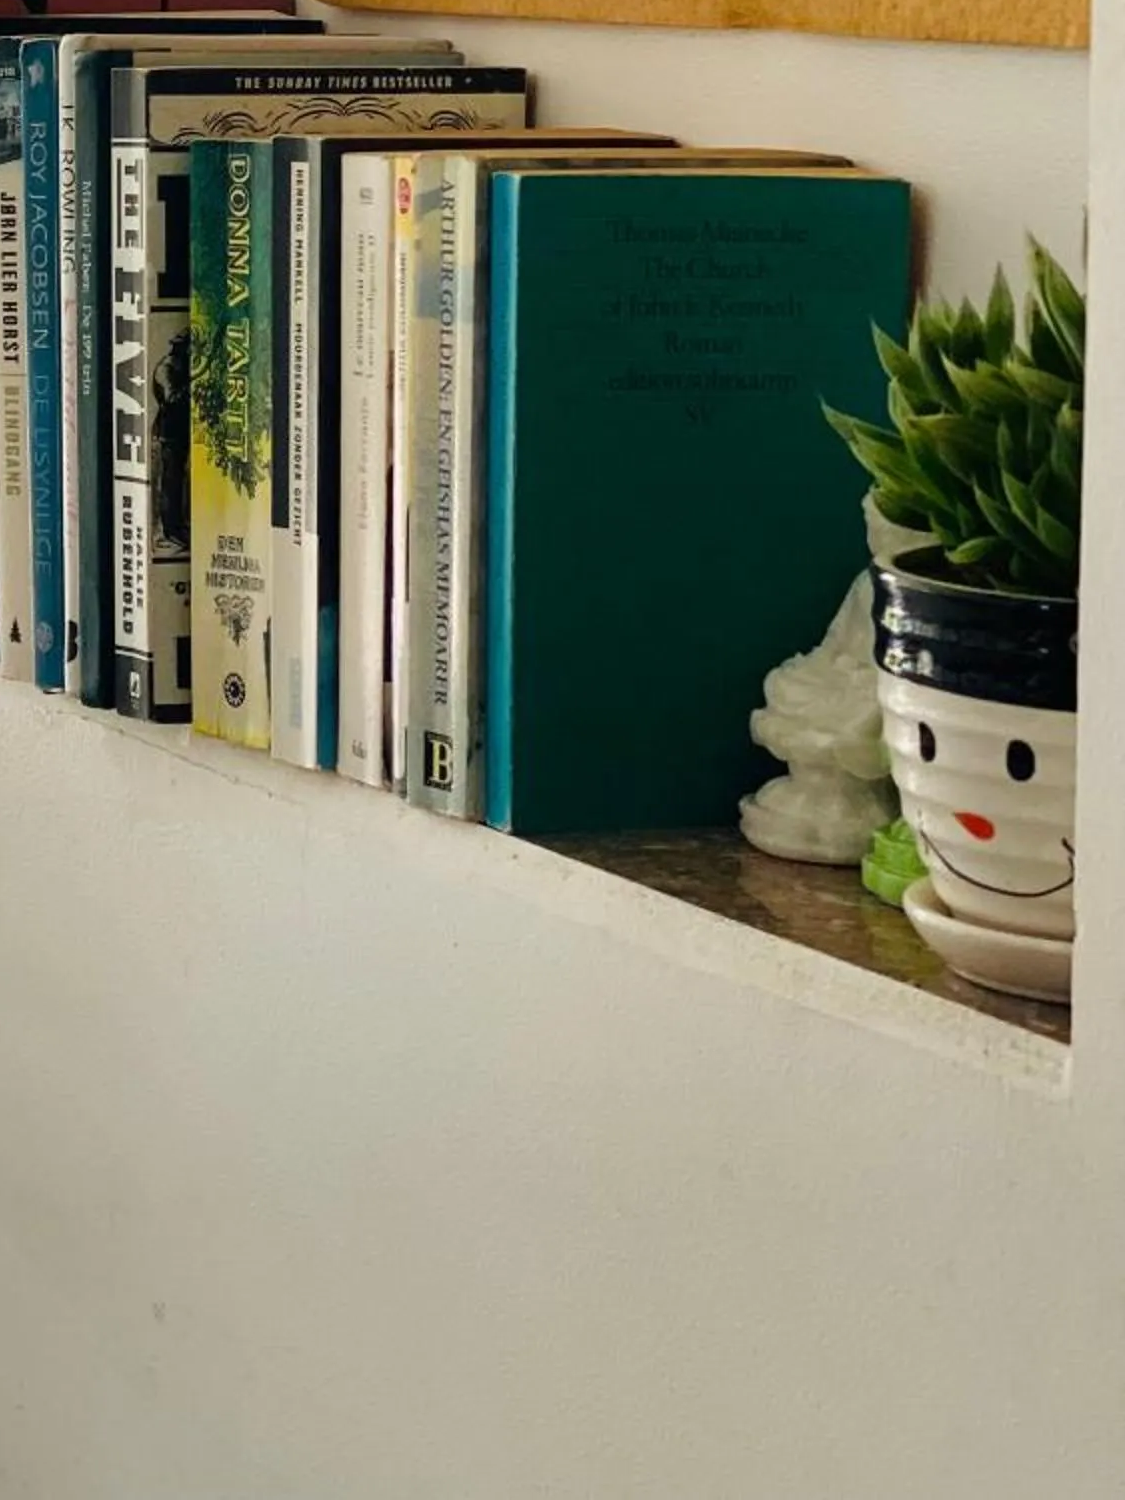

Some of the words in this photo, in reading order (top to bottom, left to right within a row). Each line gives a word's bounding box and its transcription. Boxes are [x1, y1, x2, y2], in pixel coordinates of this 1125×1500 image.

[235, 76, 261, 89] THE
[268, 76, 321, 89] SUNDAY
[328, 76, 367, 89] TIMES
[373, 75, 452, 89] BESTSELLER
[29, 120, 49, 183] ROY
[0, 191, 18, 243] JØRN
[123, 158, 140, 248] THE
[225, 153, 252, 308] DONNA
[439, 180, 456, 282] ARTHUR
[0, 250, 19, 293] LIER
[30, 194, 52, 350] JACOBSEN
[2, 301, 20, 365] HORST
[437, 288, 455, 402] GOLDEN:
[33, 373, 51, 413] DE
[223, 317, 251, 462] TARTT
[437, 408, 453, 443] EN
[3, 384, 22, 498] BLINDGANG
[217, 534, 244, 553] DEN
[436, 448, 453, 555] GEISHAS
[122, 494, 135, 636] RUBENHOLD
[433, 561, 451, 706] MEMOARER
